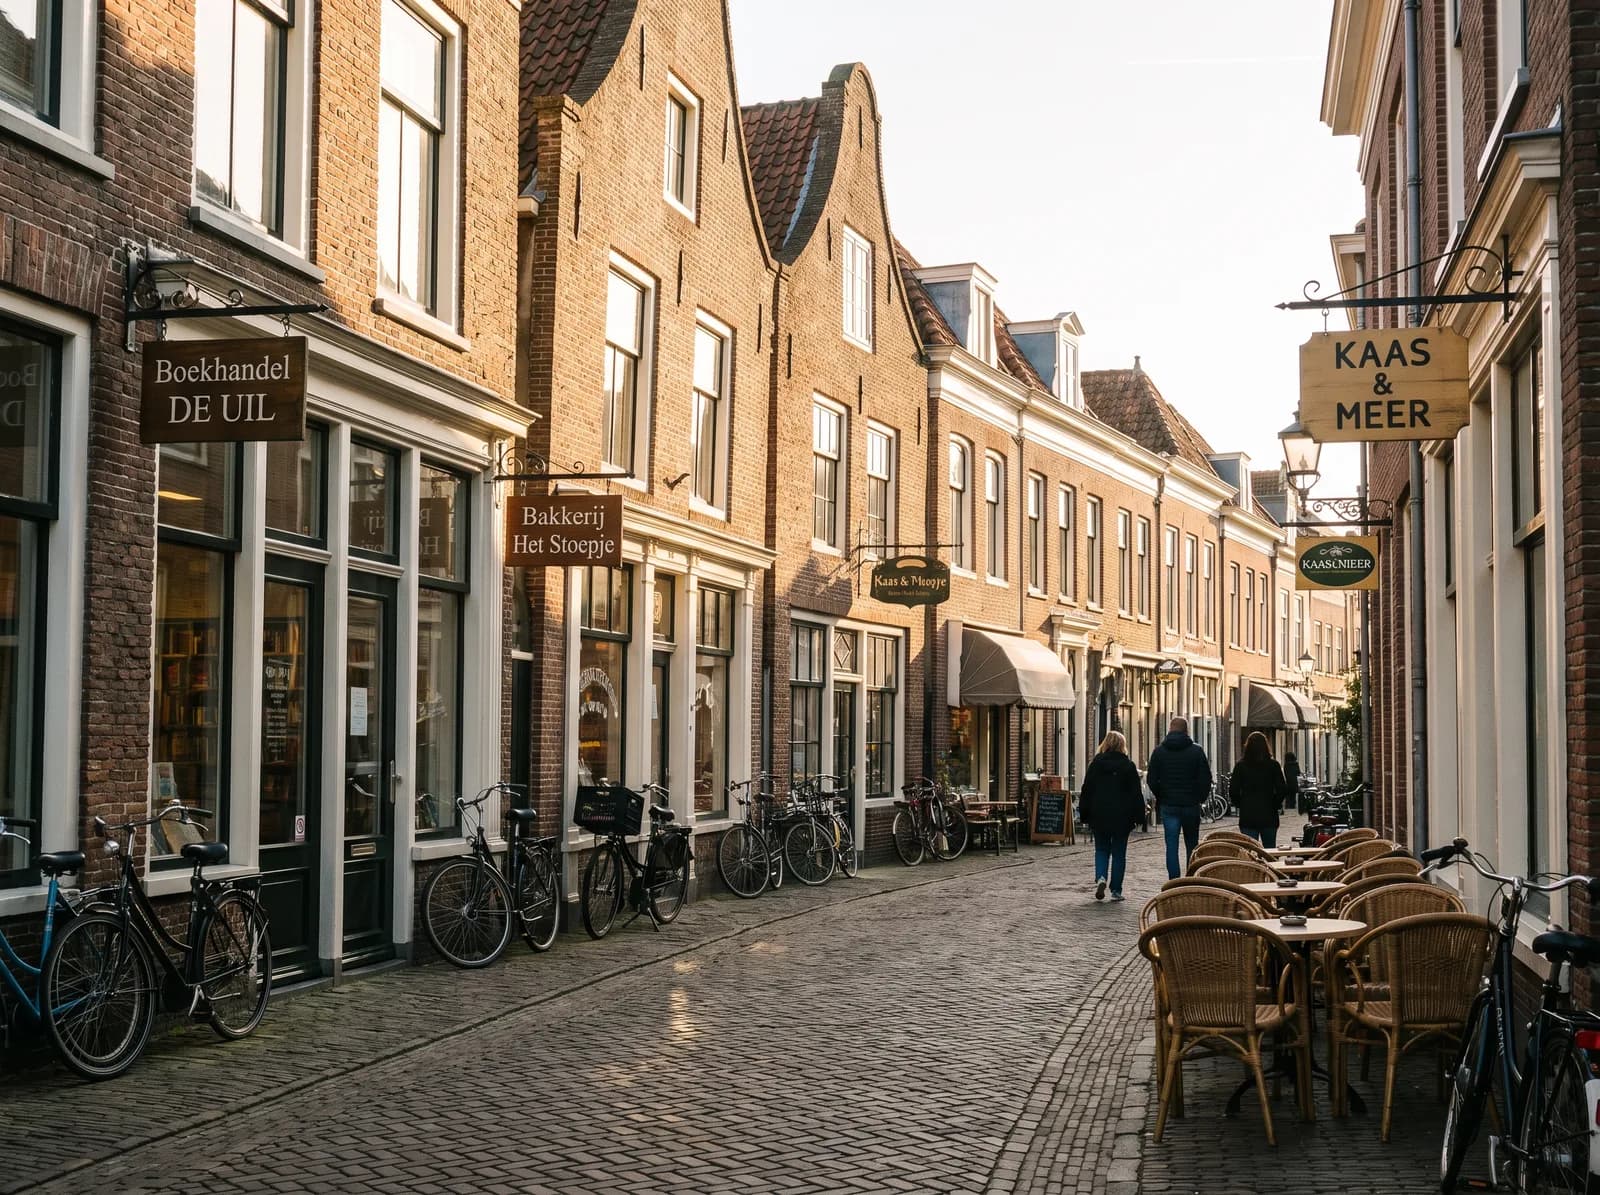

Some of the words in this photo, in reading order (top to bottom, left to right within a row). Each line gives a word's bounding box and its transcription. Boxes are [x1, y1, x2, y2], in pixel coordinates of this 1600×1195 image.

[1335, 338, 1431, 369] KAAS
[154, 354, 291, 384] Boekhandel
[1373, 372, 1393, 395] &
[168, 395, 212, 424] DE
[220, 393, 276, 423] UIL
[1336, 399, 1432, 430] MEER
[521, 505, 605, 531] Bakkerij
[512, 534, 544, 554] Het
[549, 533, 615, 559] Stoepje
[874, 575, 898, 588] Kaas
[900, 575, 908, 586] &
